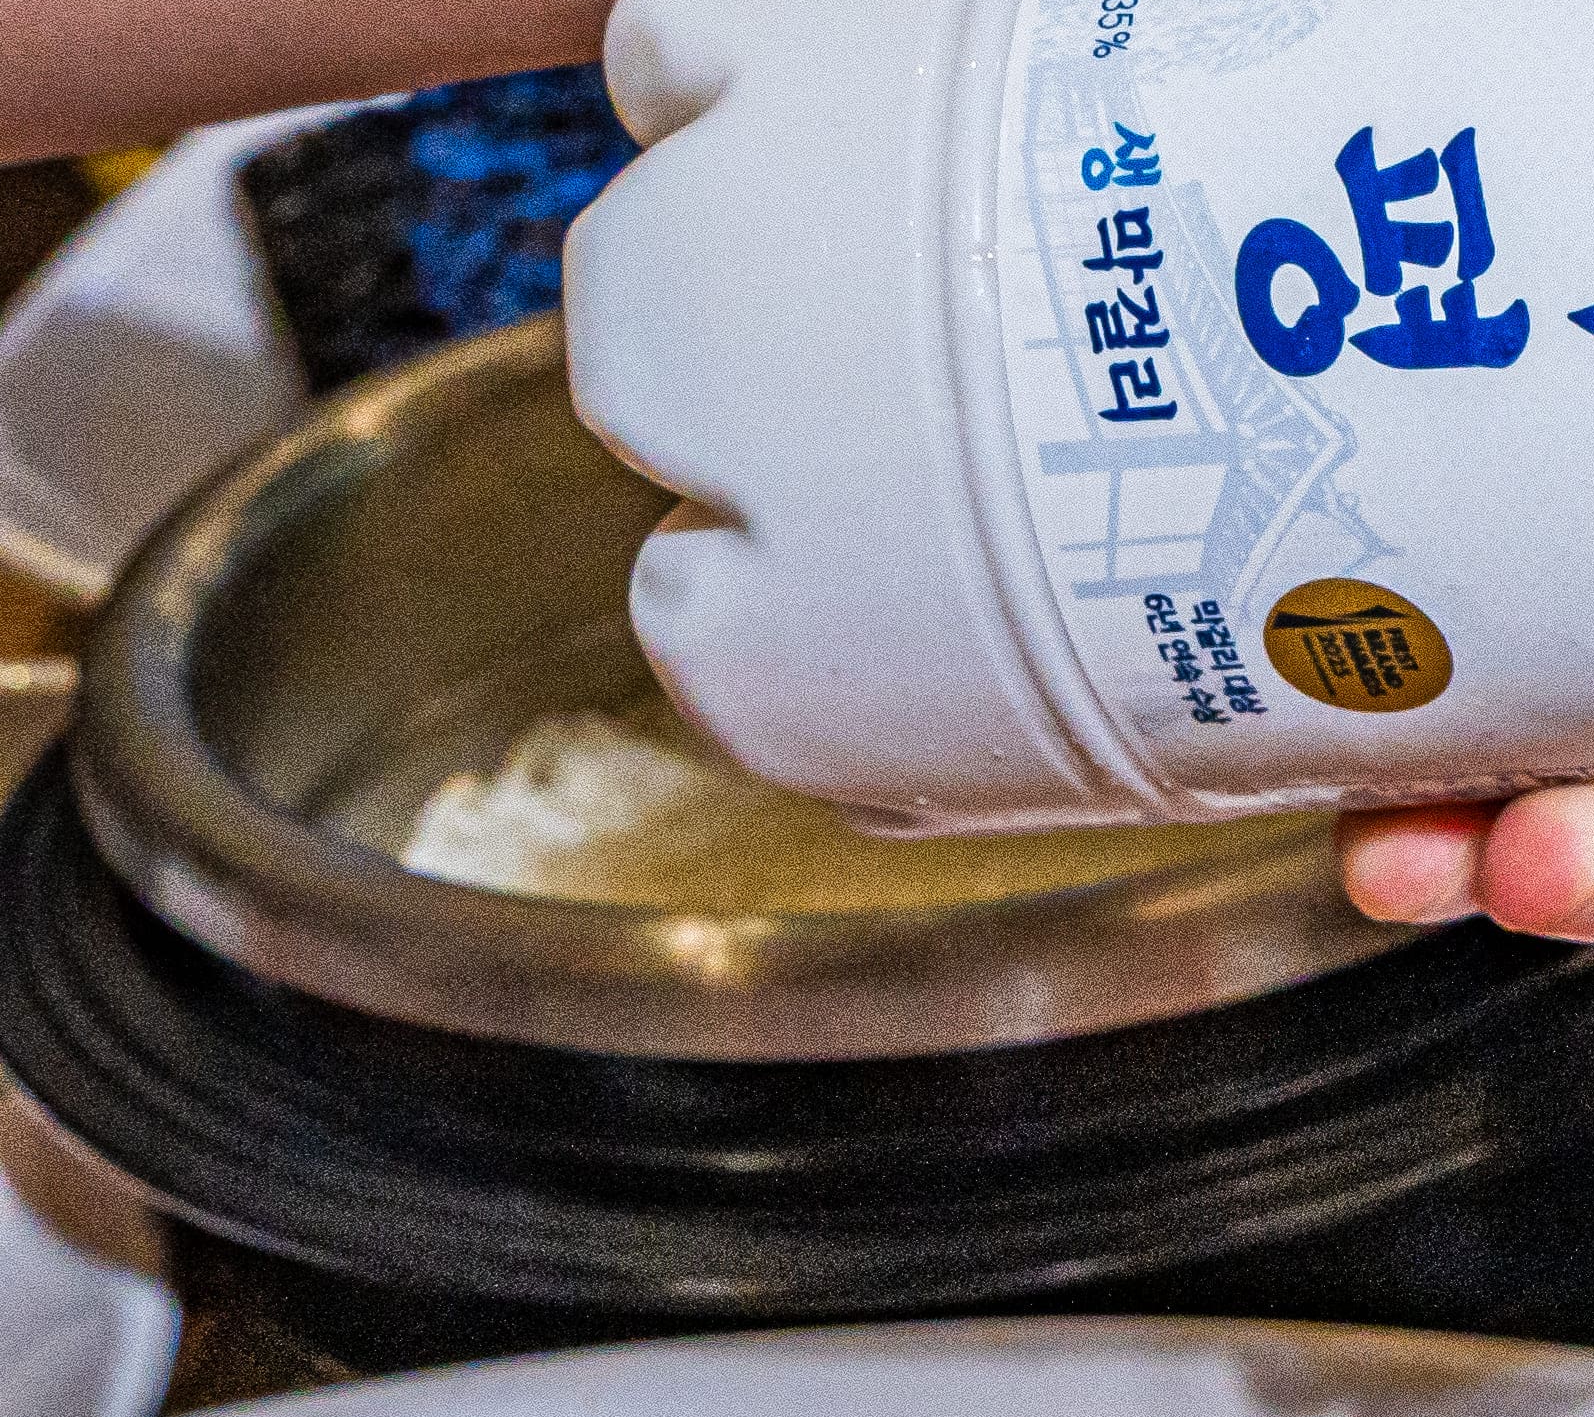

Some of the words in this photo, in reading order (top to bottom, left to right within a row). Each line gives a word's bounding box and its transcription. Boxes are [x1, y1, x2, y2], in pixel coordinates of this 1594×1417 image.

[1081, 120, 1162, 192] 생
[1082, 205, 1179, 423] 막걸리
[1143, 593, 1186, 635] 6년
[1190, 599, 1246, 671] 막걸리
[1157, 638, 1204, 683] 연속
